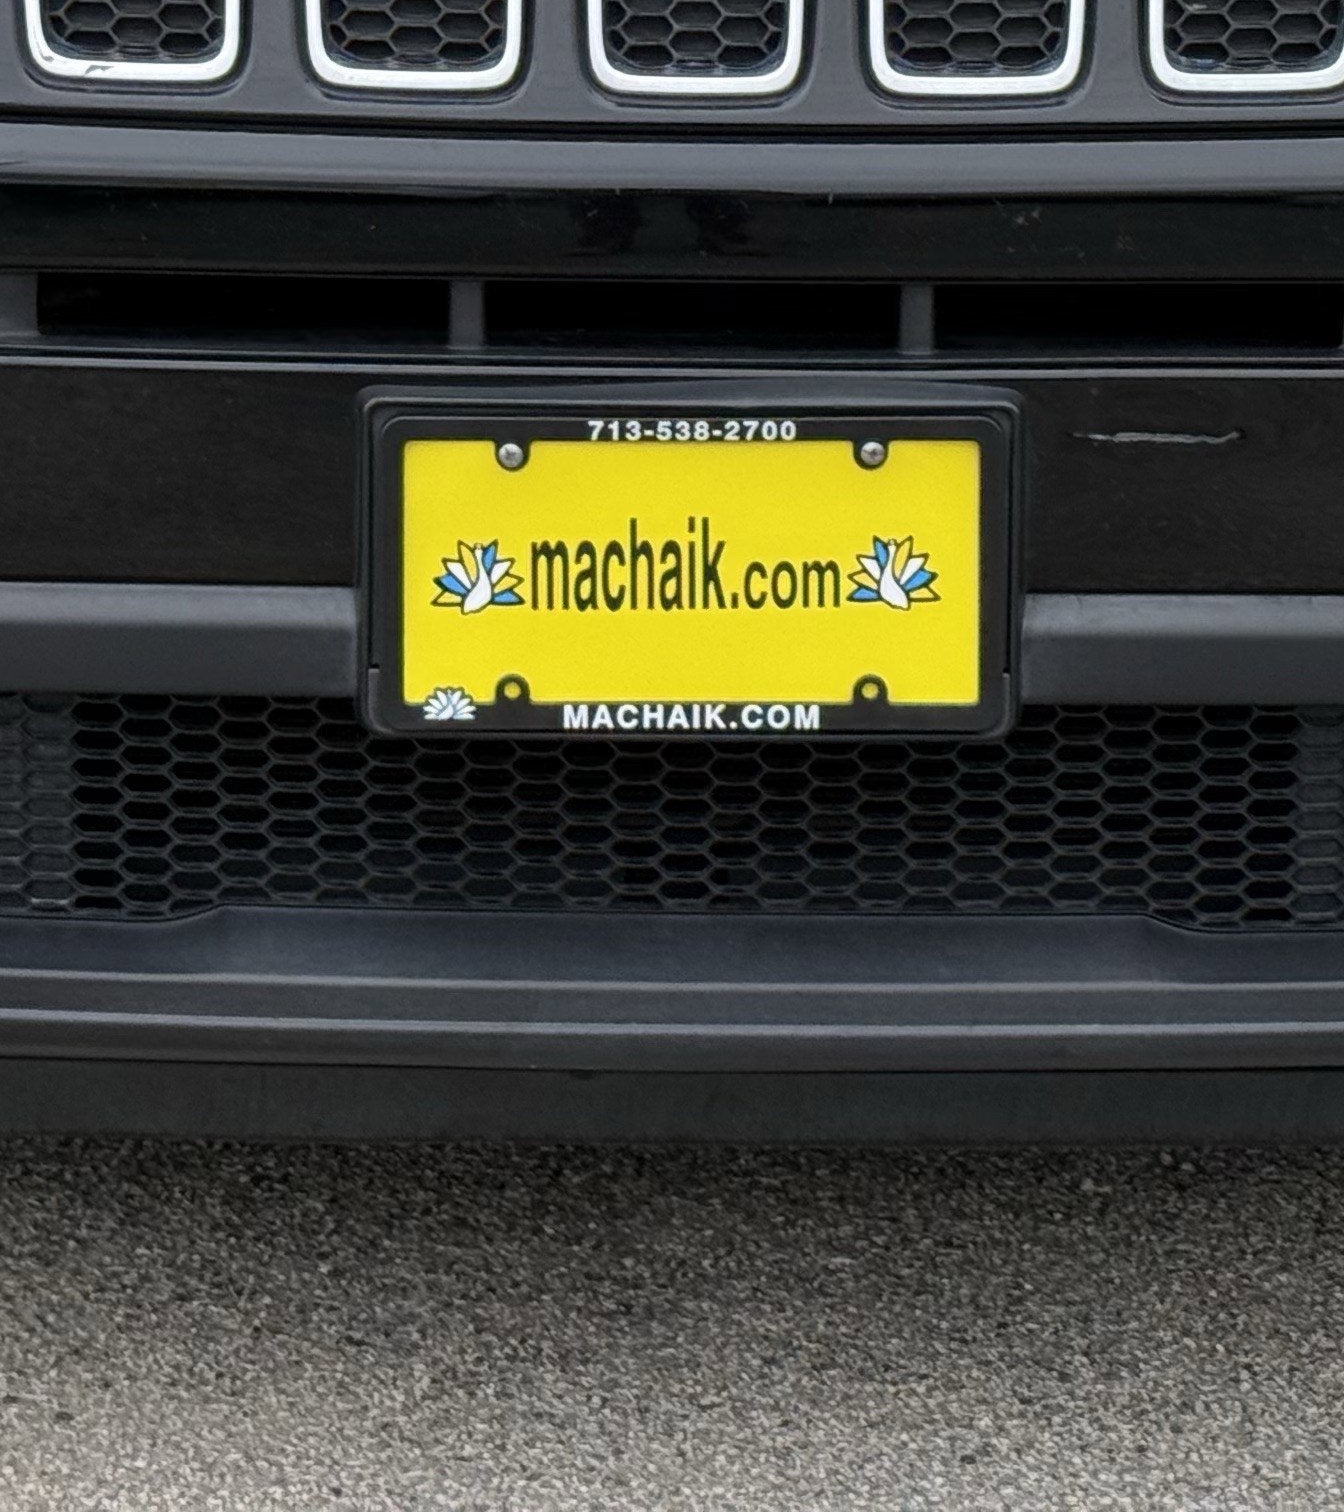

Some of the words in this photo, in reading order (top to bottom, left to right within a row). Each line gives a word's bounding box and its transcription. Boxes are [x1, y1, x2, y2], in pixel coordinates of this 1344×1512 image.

[587, 420, 797, 441] 713-538-2700
[530, 516, 841, 613] machaik.com
[562, 704, 821, 730] MACHAIK.COM
